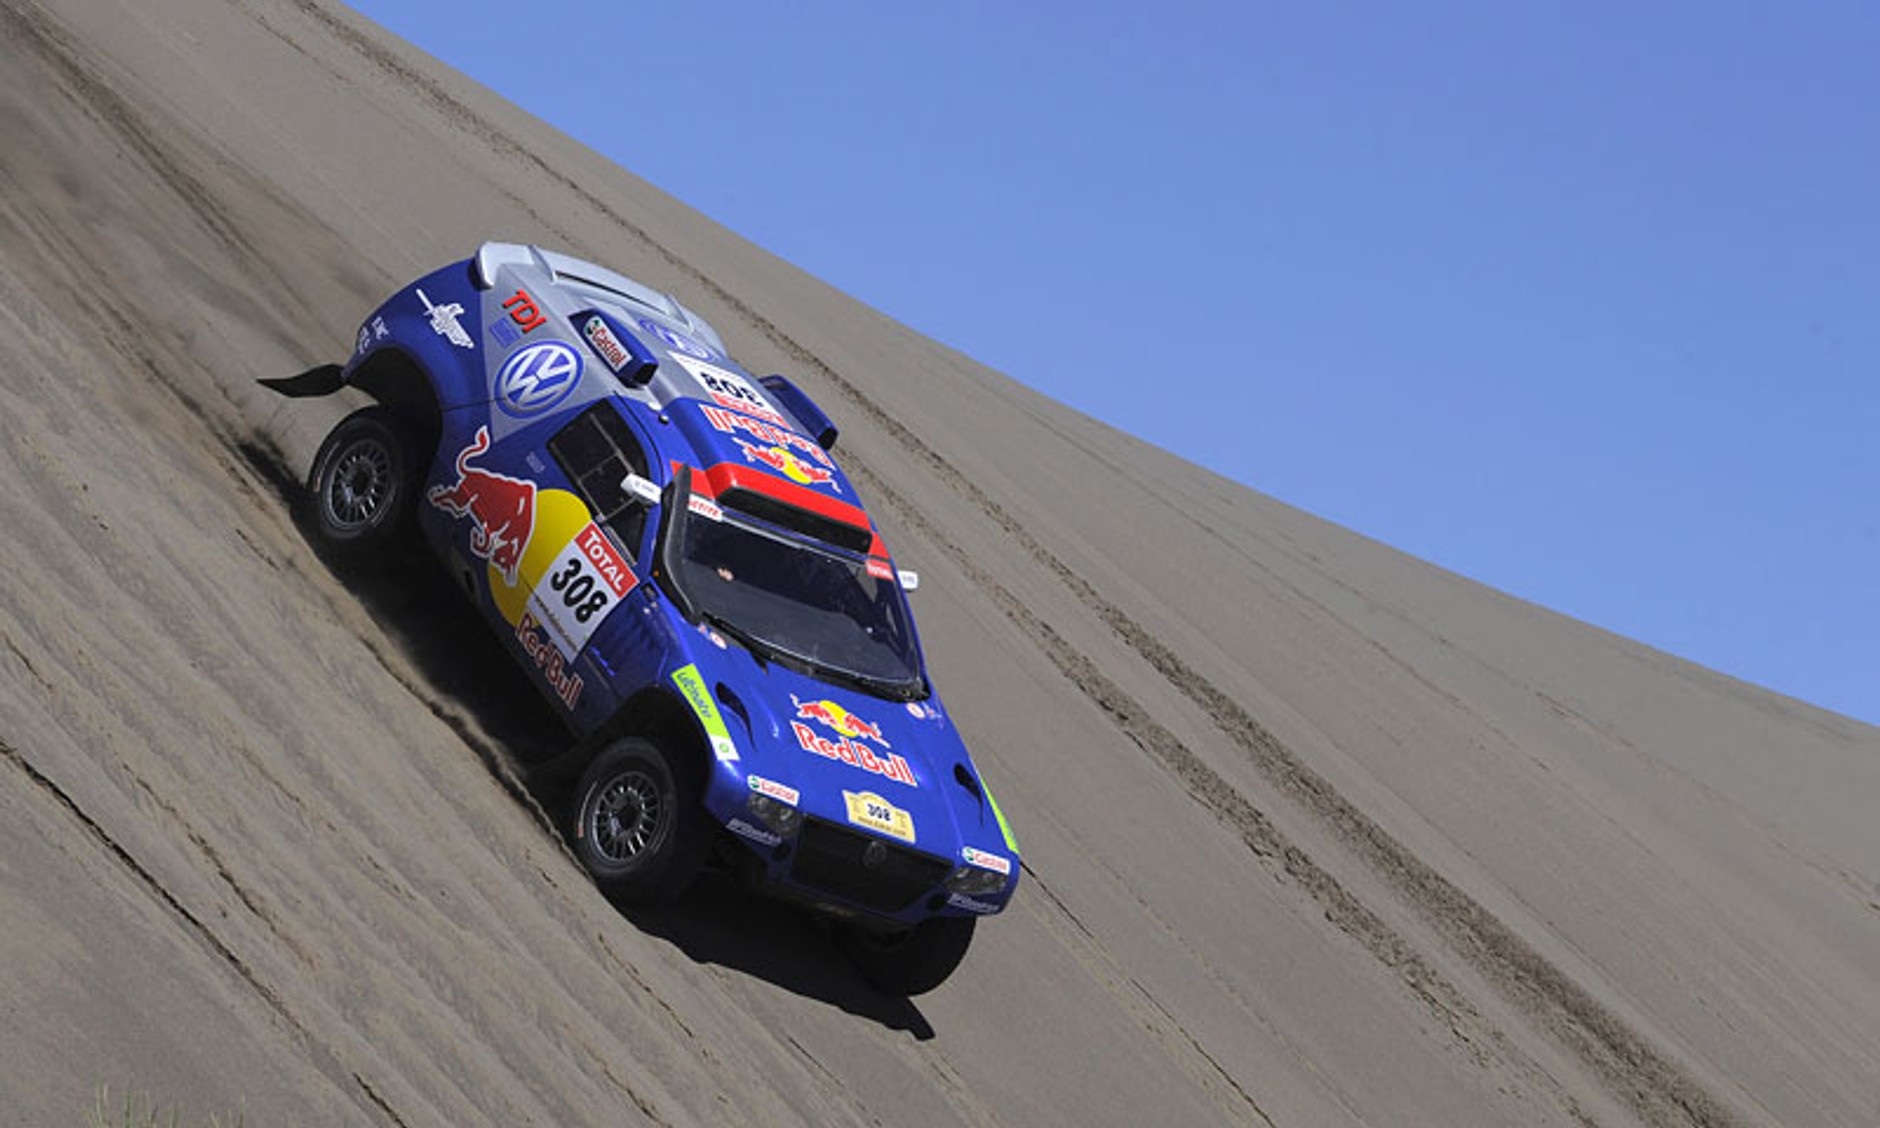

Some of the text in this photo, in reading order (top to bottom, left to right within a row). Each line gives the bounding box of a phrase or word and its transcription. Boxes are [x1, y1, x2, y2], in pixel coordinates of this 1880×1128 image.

[502, 289, 547, 333] TDI
[590, 324, 628, 367] Castrol
[500, 344, 578, 412] VW
[551, 558, 608, 624] 308
[582, 530, 623, 591] TOTAL
[515, 612, 551, 668] Red
[546, 646, 584, 710] Bull
[791, 720, 917, 786] Red Bull
[867, 803, 891, 821] 308
